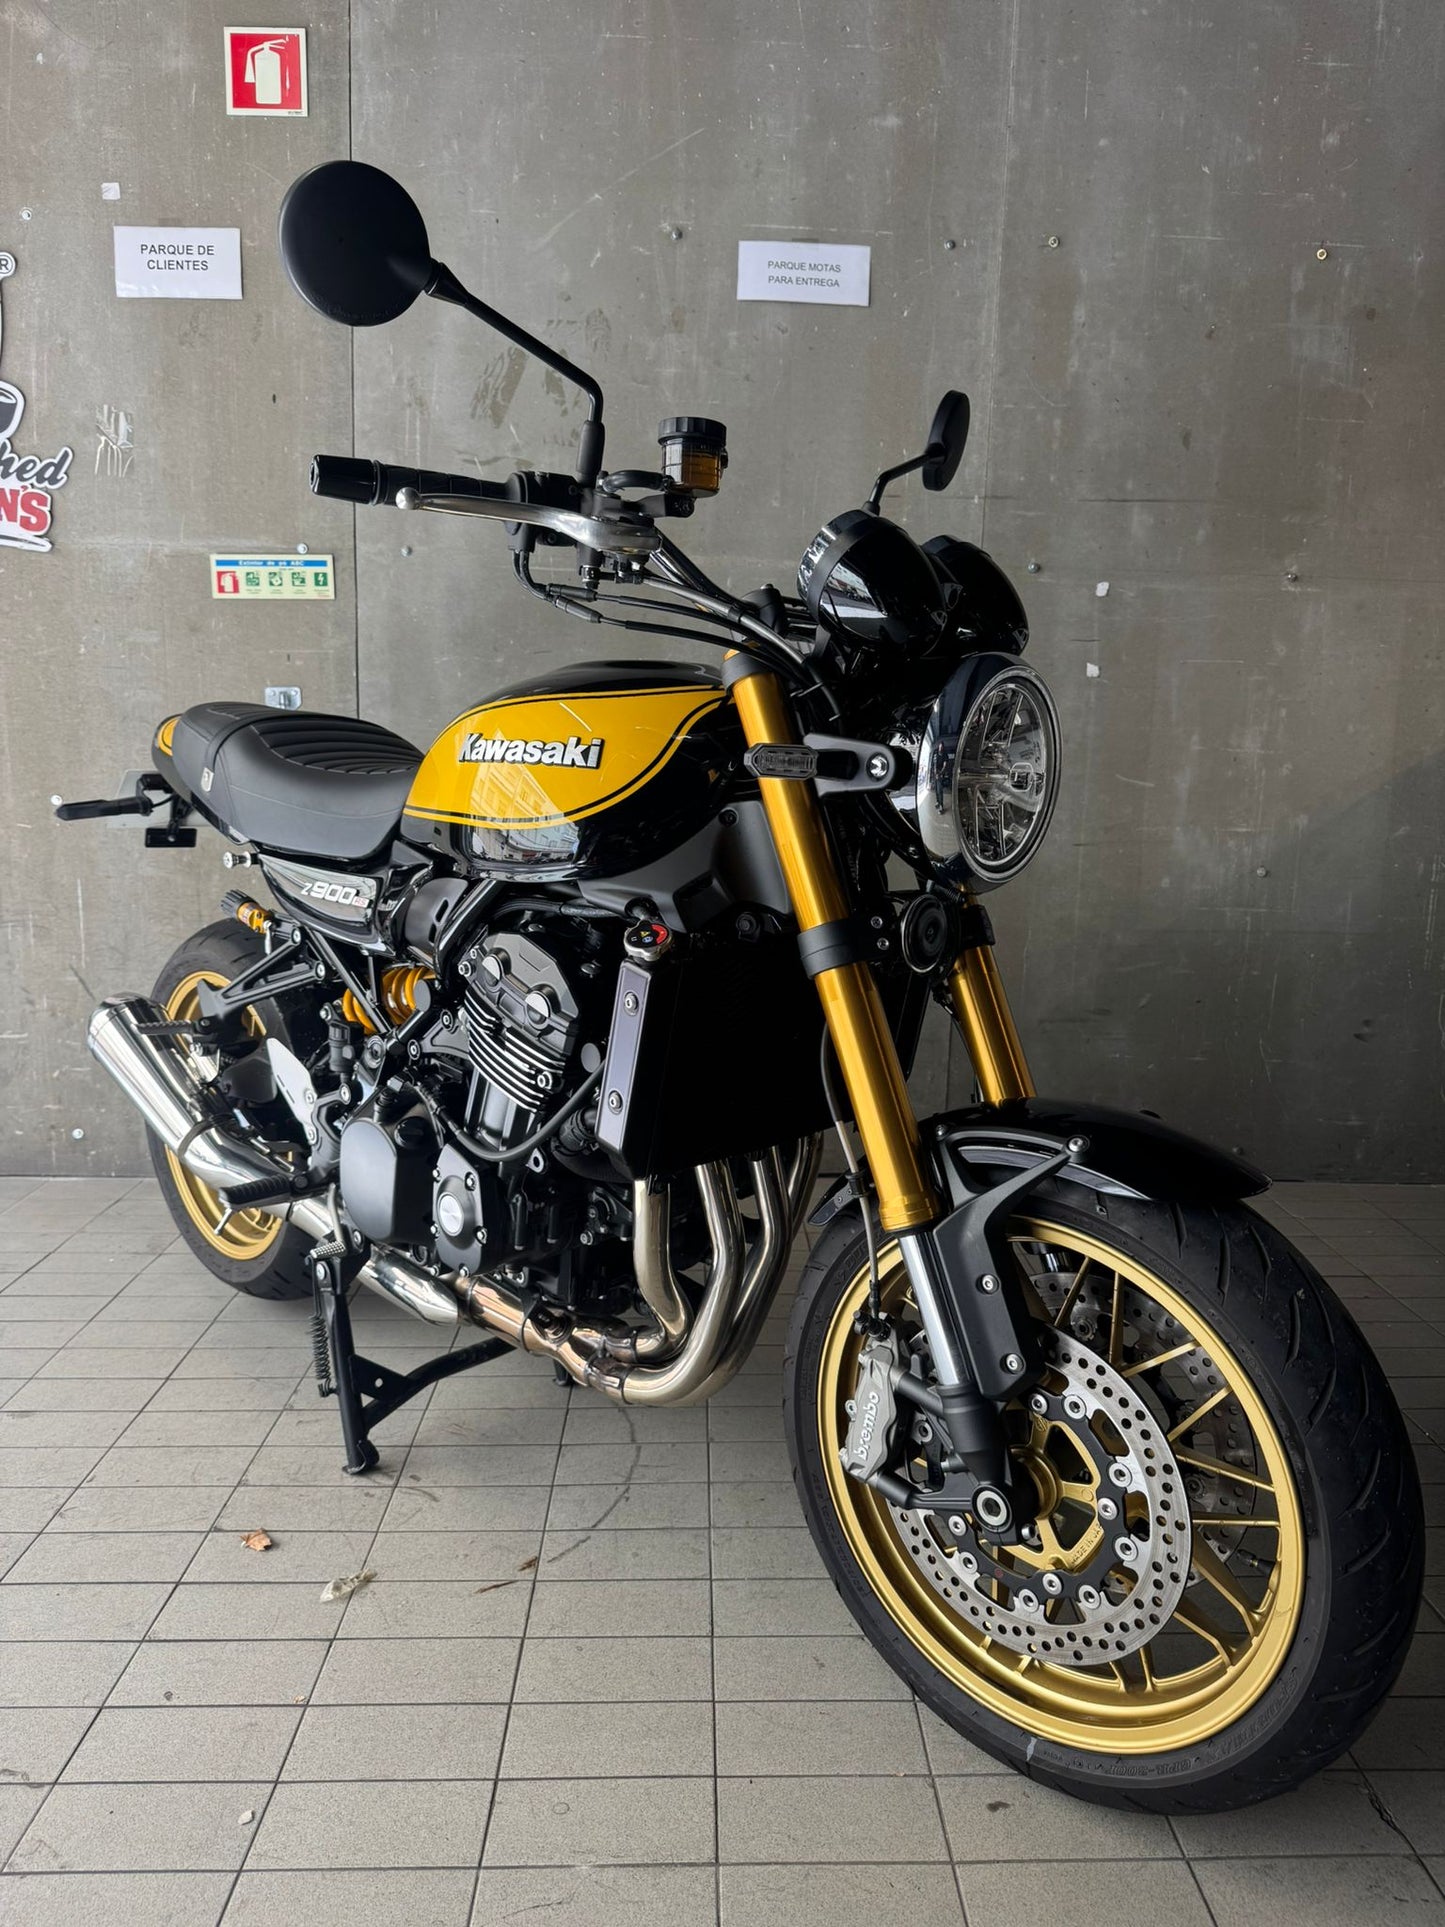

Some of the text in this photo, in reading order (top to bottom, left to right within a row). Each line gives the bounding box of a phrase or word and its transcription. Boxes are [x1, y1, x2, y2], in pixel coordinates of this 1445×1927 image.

[140, 244, 215, 255] PARQUE DE
[147, 259, 209, 271] CLIENTES
[767, 260, 841, 273] PARQUE MOTAS
[768, 275, 840, 288] PARA ENTREGA
[459, 732, 605, 769] Kawasaki
[854, 1391, 880, 1461] brembo
